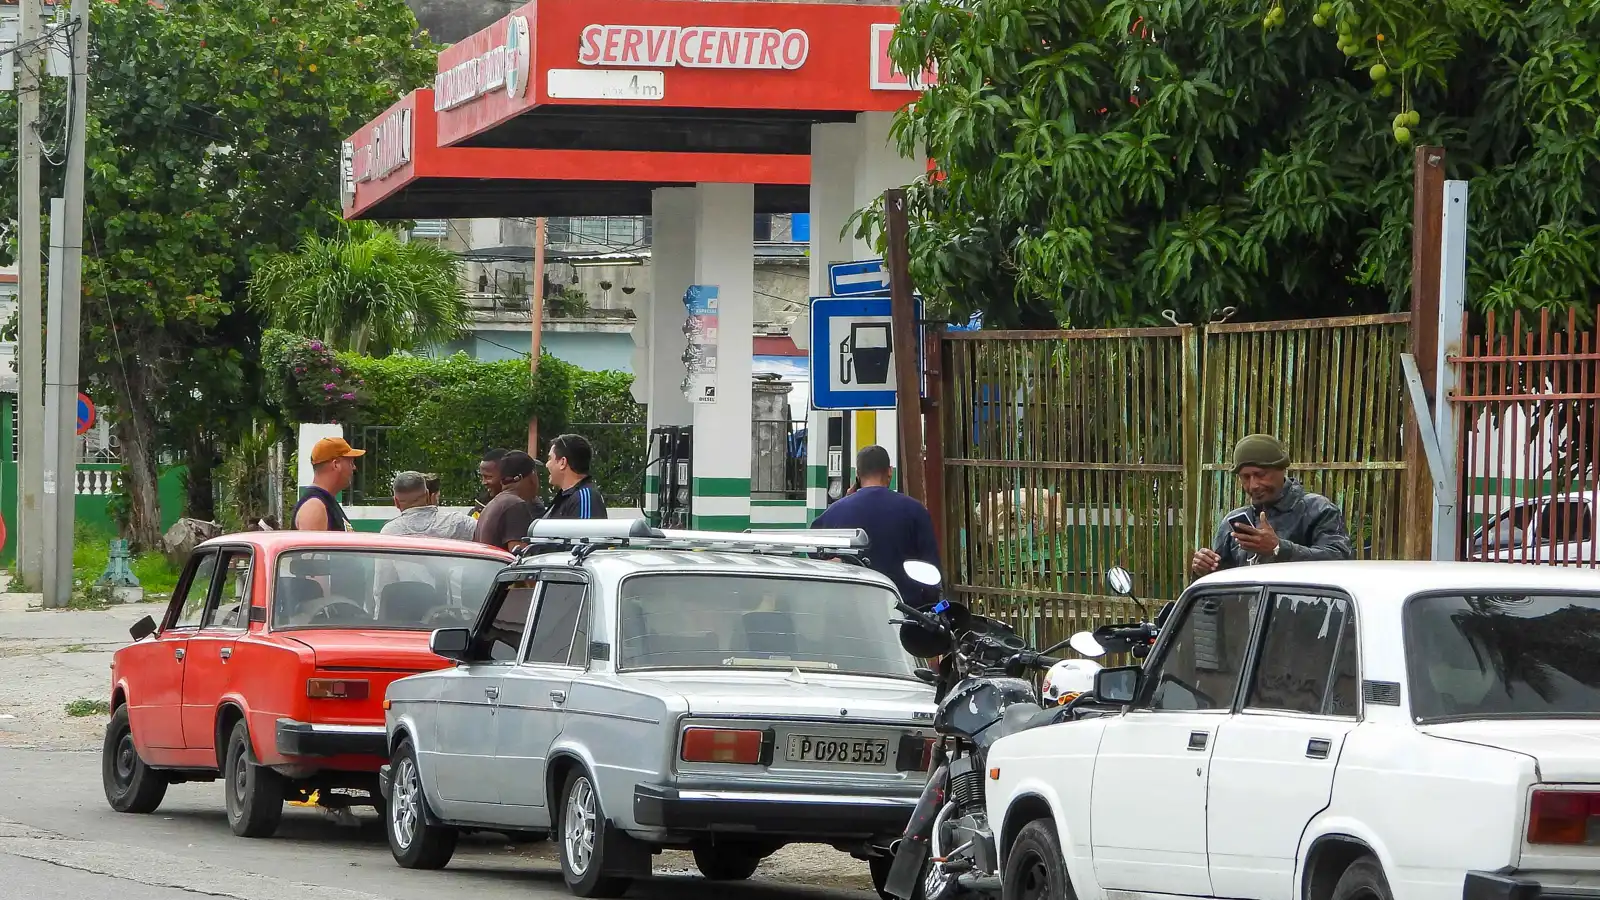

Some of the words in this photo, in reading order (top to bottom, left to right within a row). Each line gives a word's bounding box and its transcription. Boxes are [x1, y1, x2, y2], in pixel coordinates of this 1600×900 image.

[582, 27, 806, 65] SERVICENTRO
[629, 74, 639, 95] 4
[643, 85, 657, 95] m
[801, 740, 811, 760] P
[815, 741, 848, 761] 098
[852, 743, 885, 762] 553
